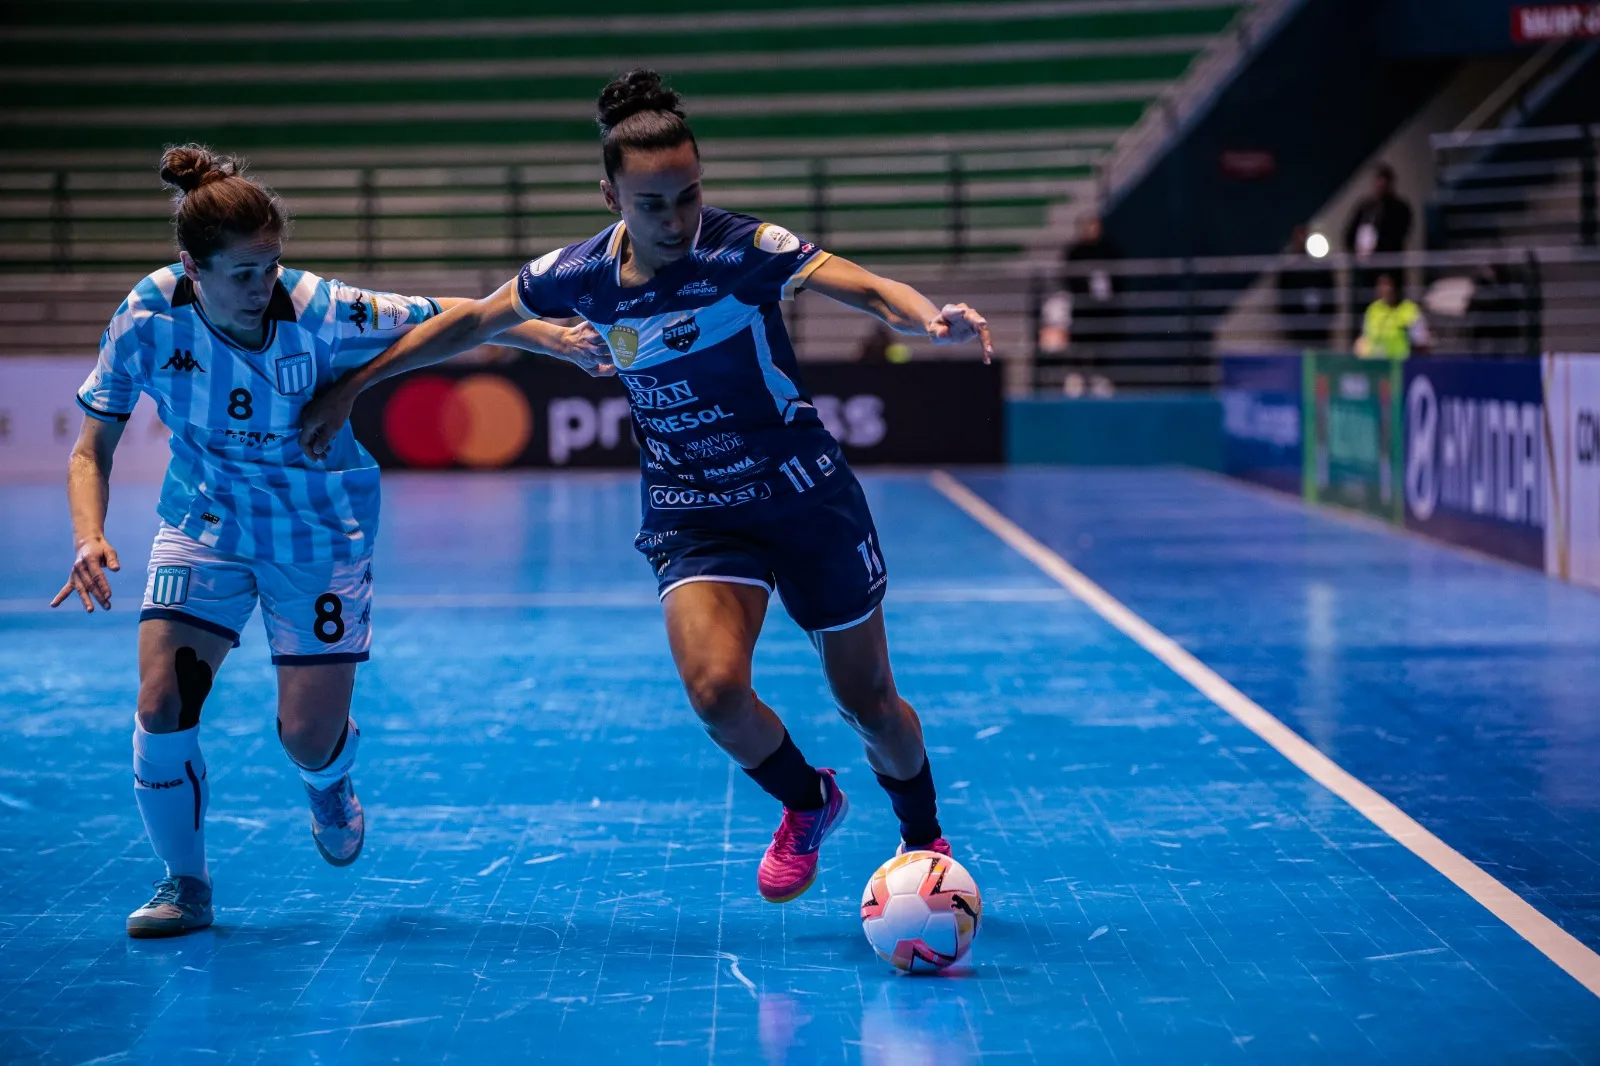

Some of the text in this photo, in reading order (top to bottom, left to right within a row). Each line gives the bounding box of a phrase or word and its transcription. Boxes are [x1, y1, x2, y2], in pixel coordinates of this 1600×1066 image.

[664, 323, 697, 340] STEIN
[280, 355, 309, 367] RACING
[227, 388, 254, 420] 8
[630, 383, 693, 408] VAN
[778, 456, 816, 493] 11
[158, 567, 187, 575] RACING
[856, 531, 883, 583] 11
[313, 592, 345, 644] 8
